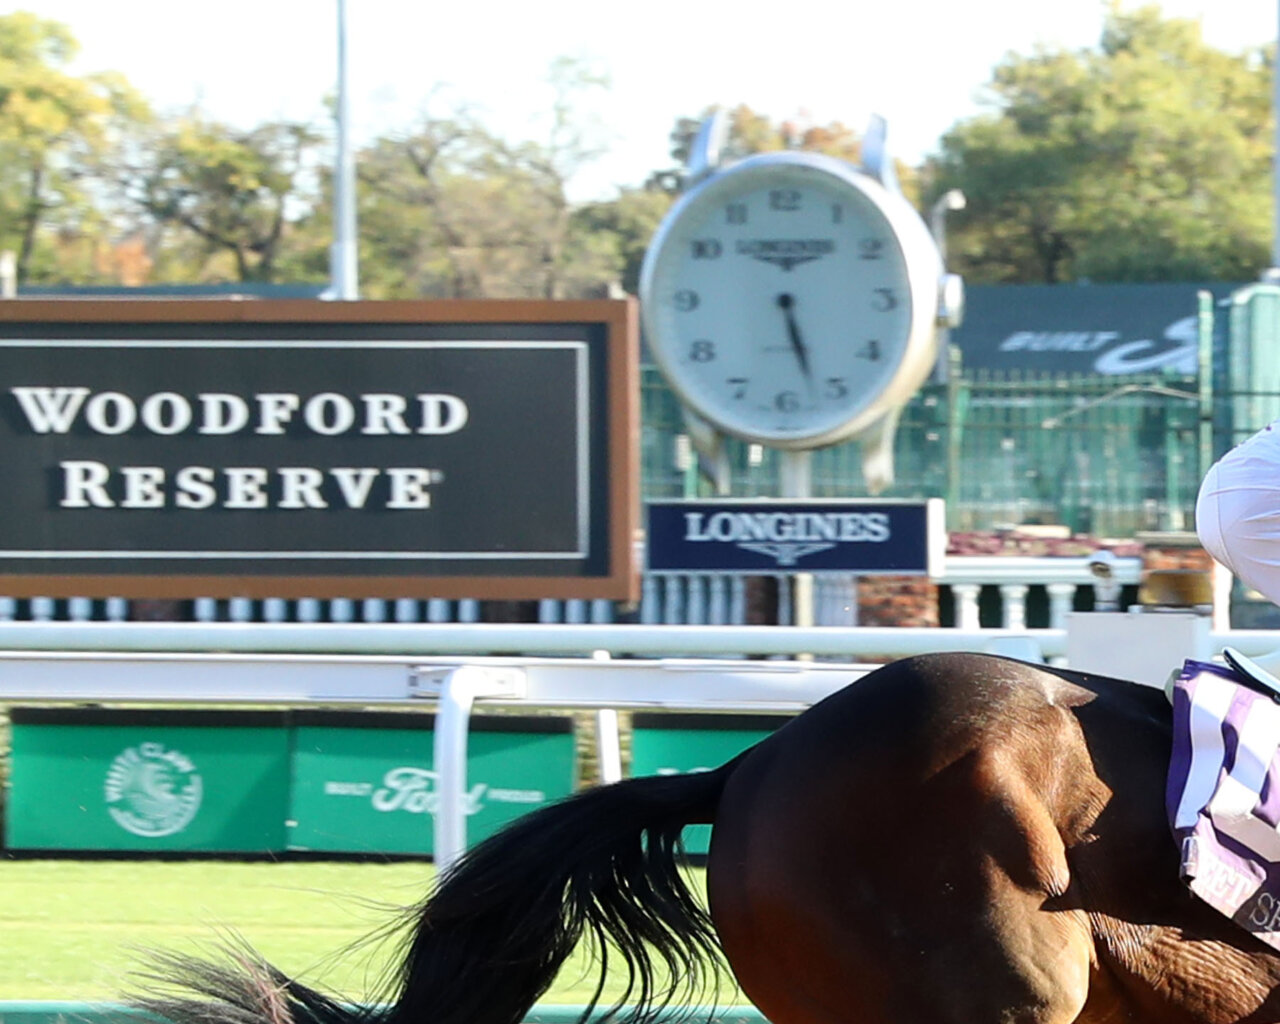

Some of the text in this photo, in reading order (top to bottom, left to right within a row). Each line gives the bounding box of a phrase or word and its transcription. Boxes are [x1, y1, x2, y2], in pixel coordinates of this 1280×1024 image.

[11, 388, 469, 435] WOODFORD
[60, 461, 432, 509] RESERVE
[685, 512, 890, 543] LONGINES
